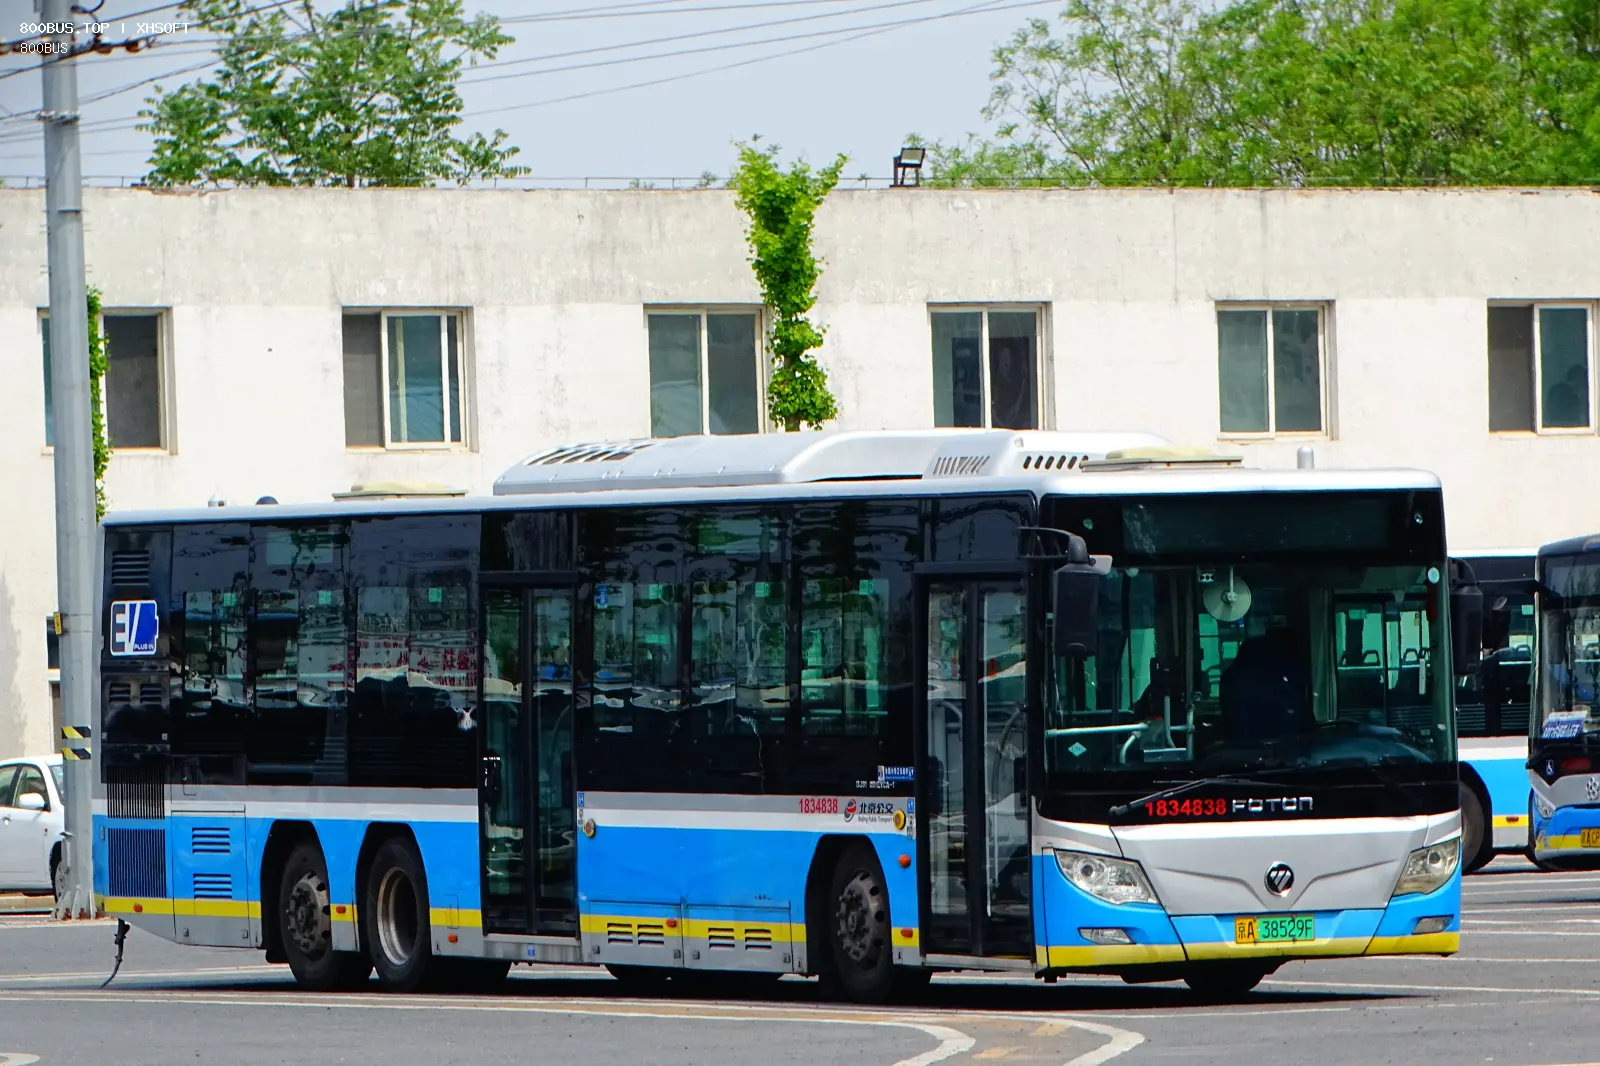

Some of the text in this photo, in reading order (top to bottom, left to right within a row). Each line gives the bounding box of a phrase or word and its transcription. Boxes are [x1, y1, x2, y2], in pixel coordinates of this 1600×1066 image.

[799, 798, 838, 814] 1834838
[859, 802, 894, 814] 北京公交
[1145, 799, 1226, 816] 1834838
[1232, 797, 1314, 813] FOTON
[1238, 919, 1313, 939] 京A 38529F
